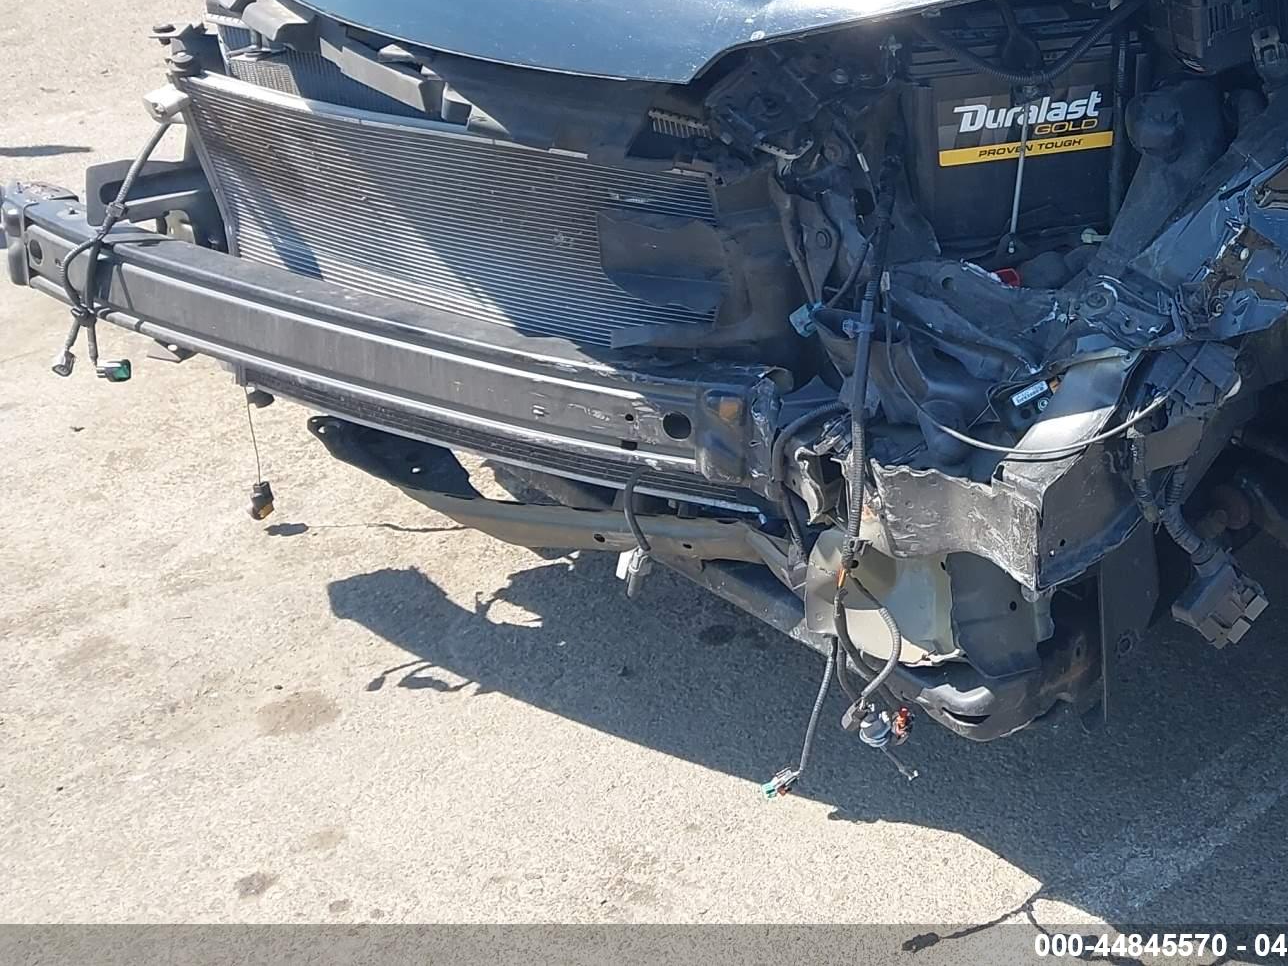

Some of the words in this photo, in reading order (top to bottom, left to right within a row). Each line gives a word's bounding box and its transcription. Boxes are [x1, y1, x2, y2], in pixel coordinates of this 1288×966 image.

[953, 90, 1102, 133] Duralast
[1033, 118, 1099, 135] GOLD
[978, 144, 1034, 158] PROVEN
[1037, 138, 1084, 151] TOUGH
